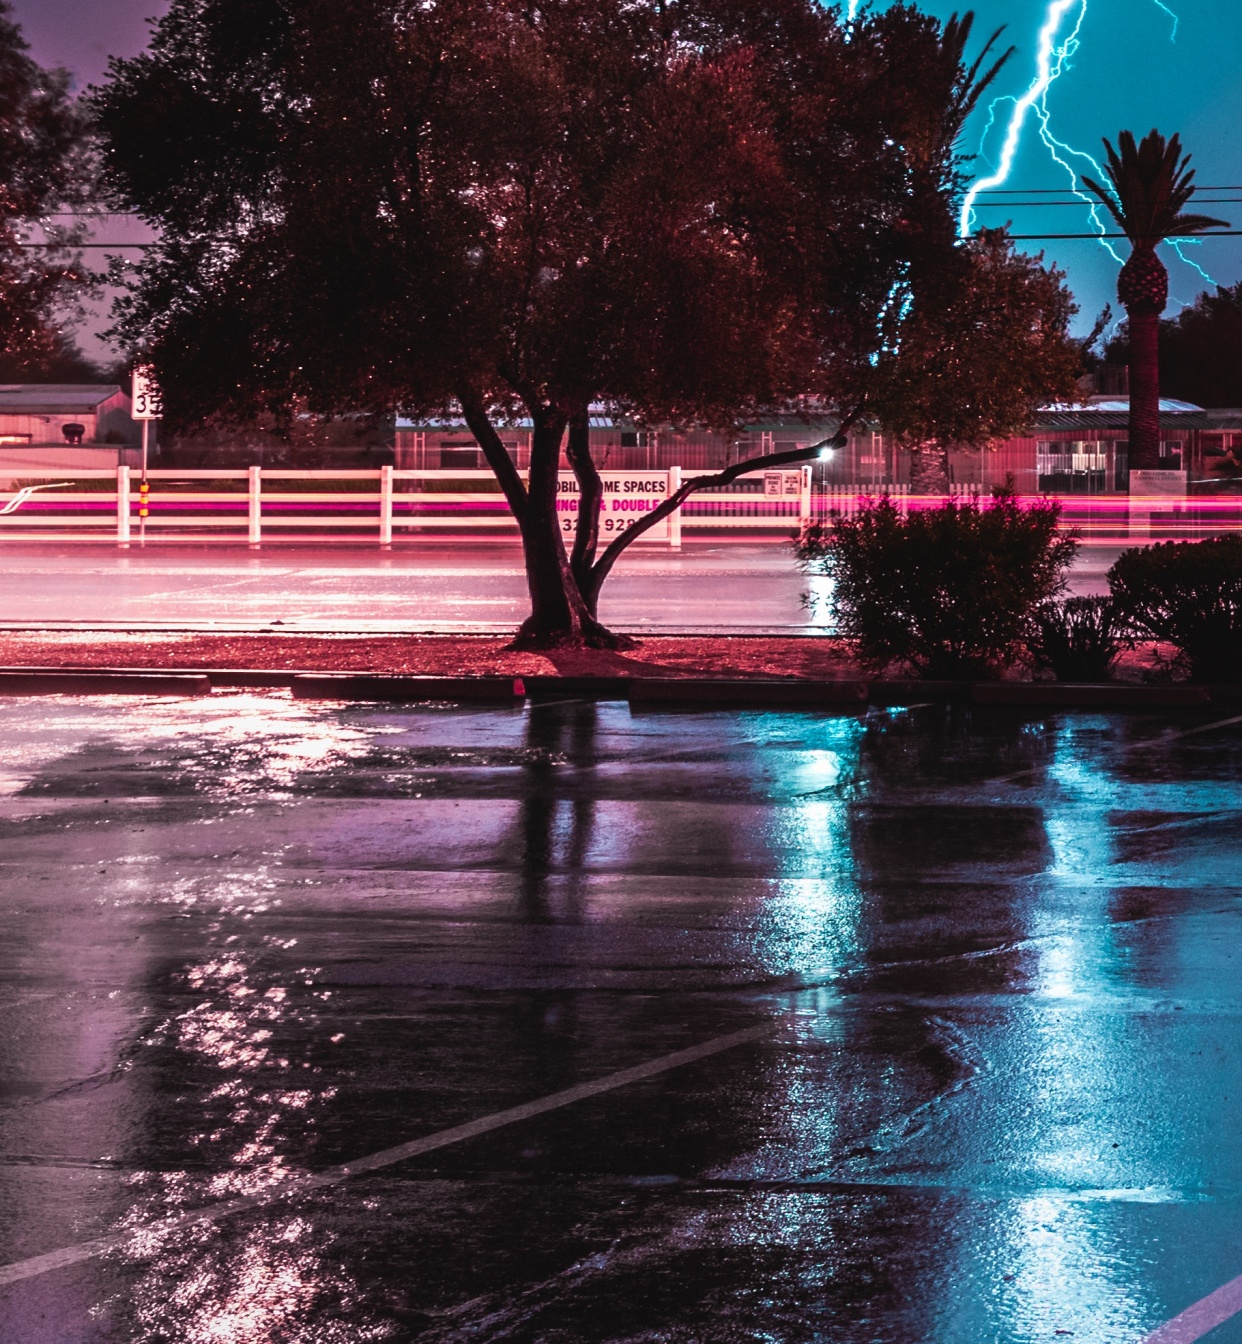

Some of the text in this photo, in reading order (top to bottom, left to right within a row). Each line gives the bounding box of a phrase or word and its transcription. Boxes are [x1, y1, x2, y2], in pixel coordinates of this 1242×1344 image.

[136, 395, 163, 414] 35
[604, 481, 620, 492] ME
[623, 481, 666, 492] SPACES
[612, 499, 660, 512] DOUBLE
